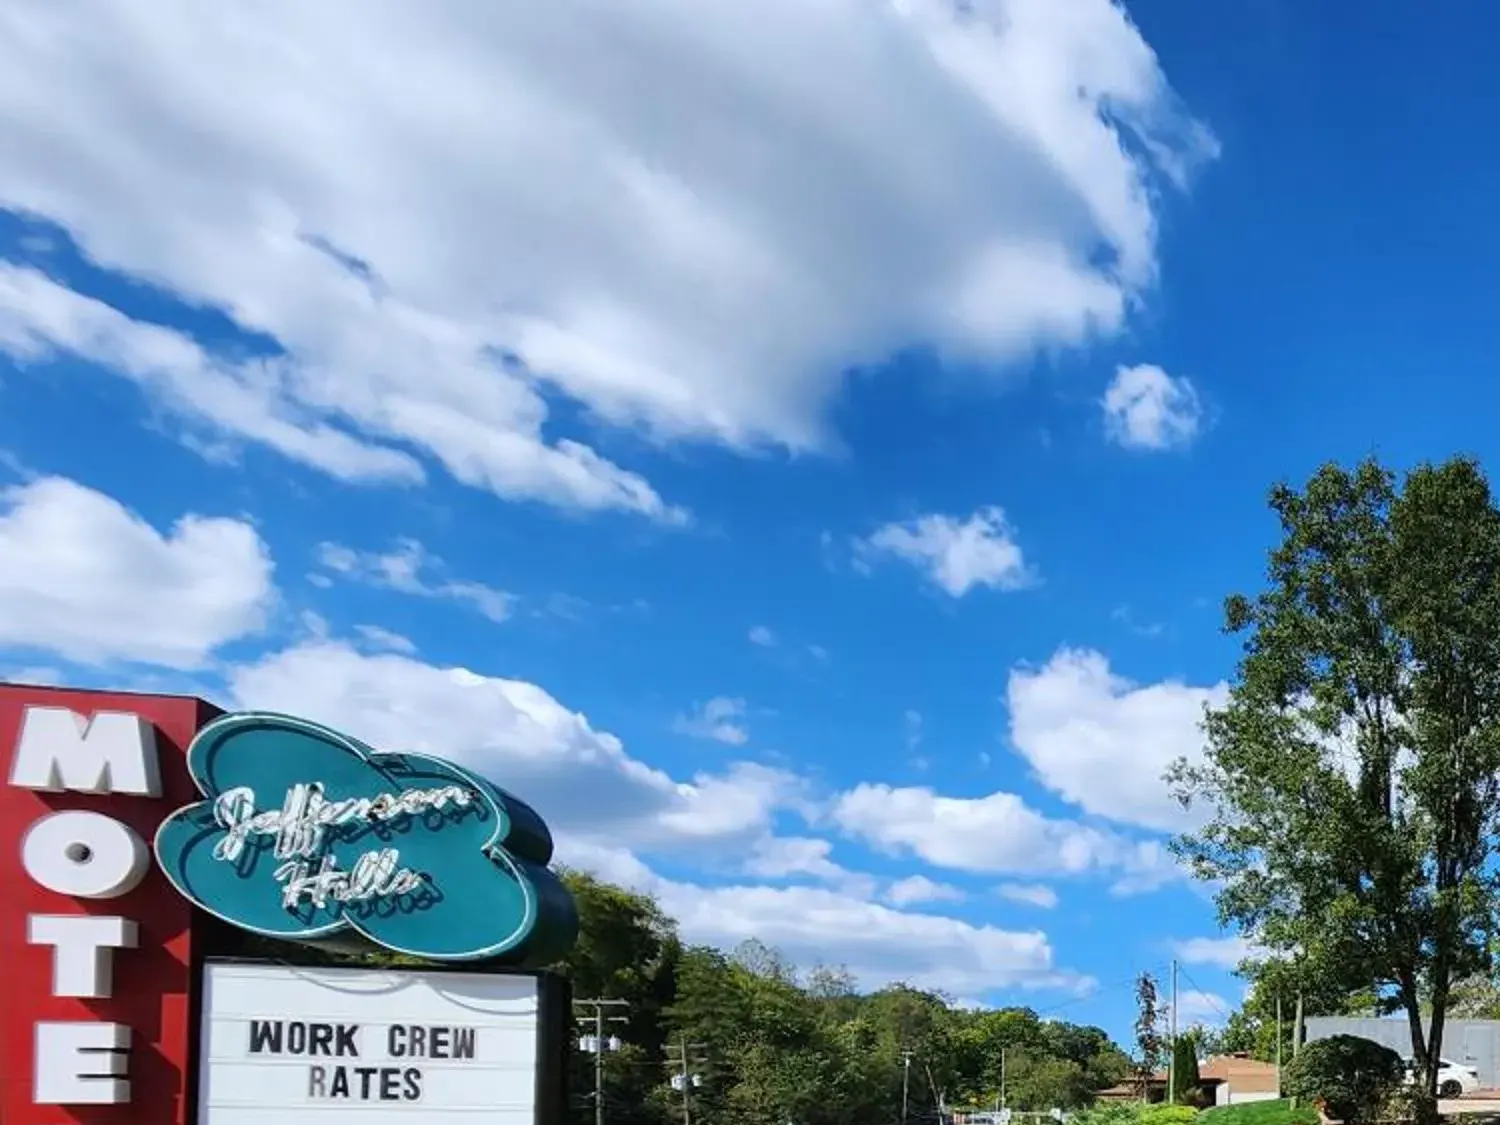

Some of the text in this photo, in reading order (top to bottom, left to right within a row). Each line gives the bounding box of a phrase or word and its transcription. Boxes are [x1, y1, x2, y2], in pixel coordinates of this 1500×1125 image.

[213, 781, 481, 860] Jefferson
[249, 1020, 475, 1058] WORK CREW
[308, 1066, 421, 1100] RATES
